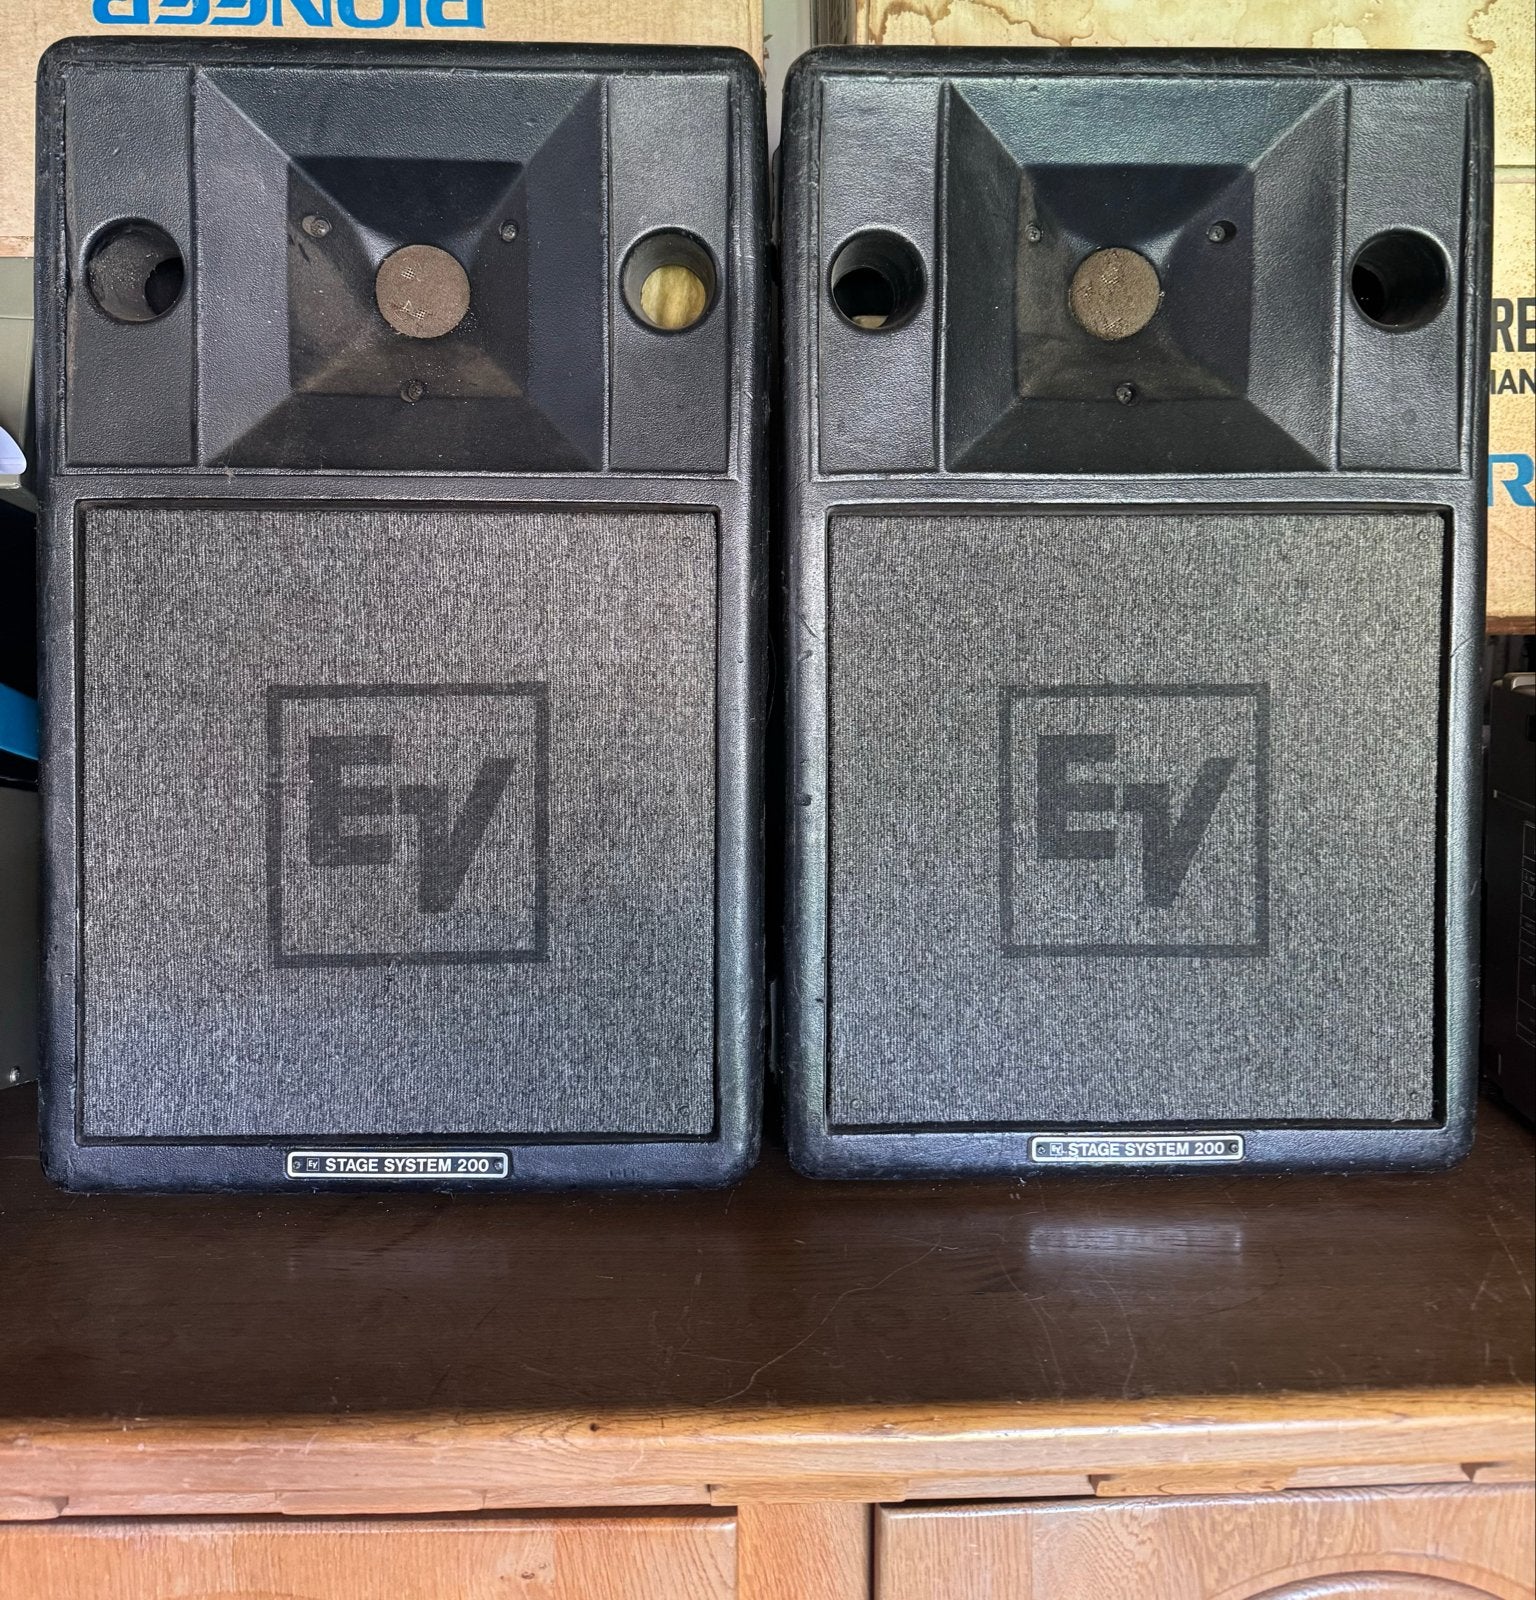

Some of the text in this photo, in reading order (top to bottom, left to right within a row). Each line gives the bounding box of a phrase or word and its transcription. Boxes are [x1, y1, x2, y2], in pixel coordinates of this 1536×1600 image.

[309, 734, 516, 913] EV
[1037, 733, 1238, 909] EV
[325, 1158, 379, 1172] STAGE
[384, 1158, 451, 1172] SYSTEM
[457, 1158, 489, 1172] 200
[1068, 1142, 1120, 1157] STAGE
[1125, 1142, 1189, 1156] SYSTEM
[1195, 1141, 1224, 1155] 200
